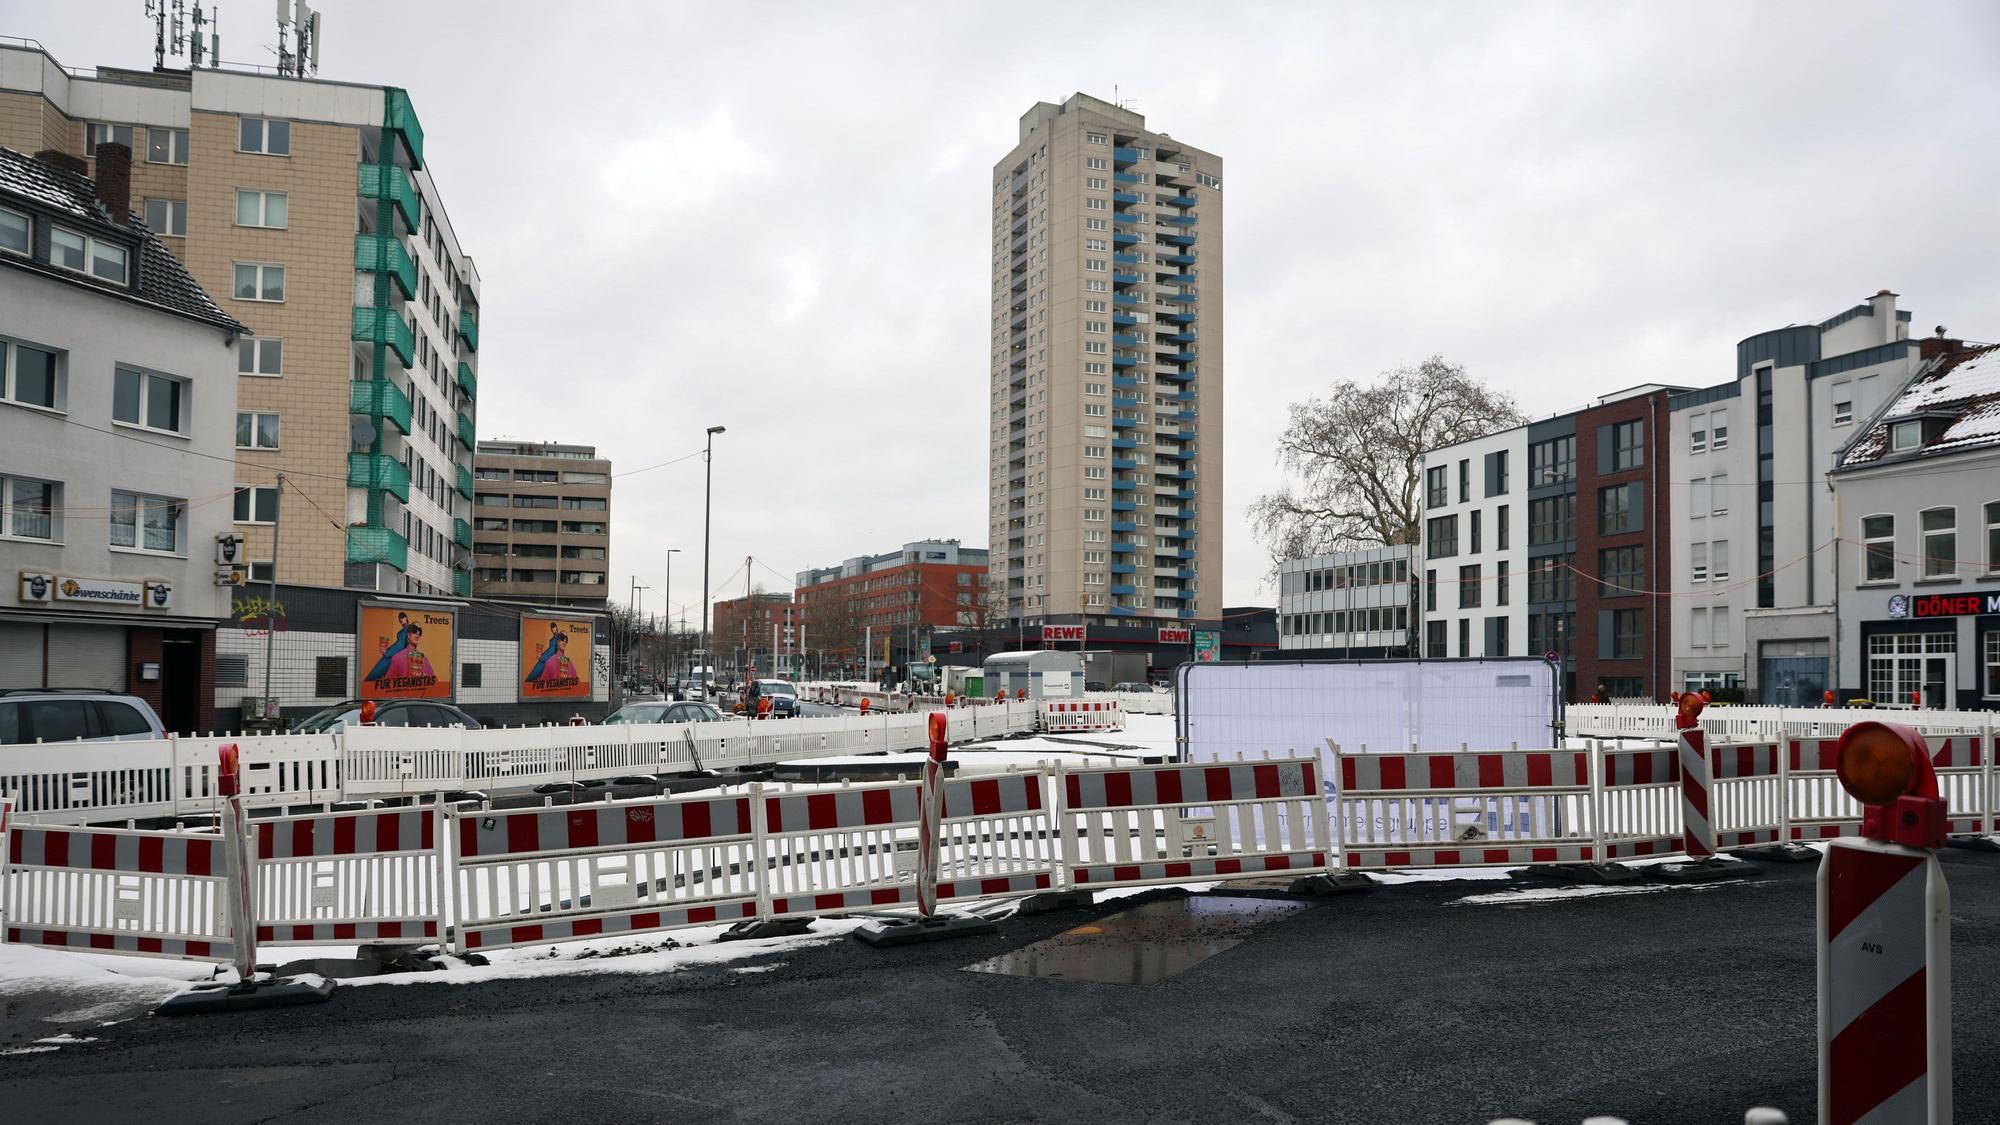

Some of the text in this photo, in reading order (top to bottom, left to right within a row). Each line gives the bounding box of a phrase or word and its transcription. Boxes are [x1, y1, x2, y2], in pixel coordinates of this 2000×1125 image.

[1917, 595, 1981, 616] DÖNER
[424, 615, 449, 625] Treets
[569, 625, 589, 634] Treets
[1044, 627, 1084, 639] REWE
[1160, 630, 1189, 642] REWE
[393, 675, 436, 688] VEGANISTAS
[547, 677, 579, 688] VEGANISTAS
[1861, 942, 1882, 954] AVS
